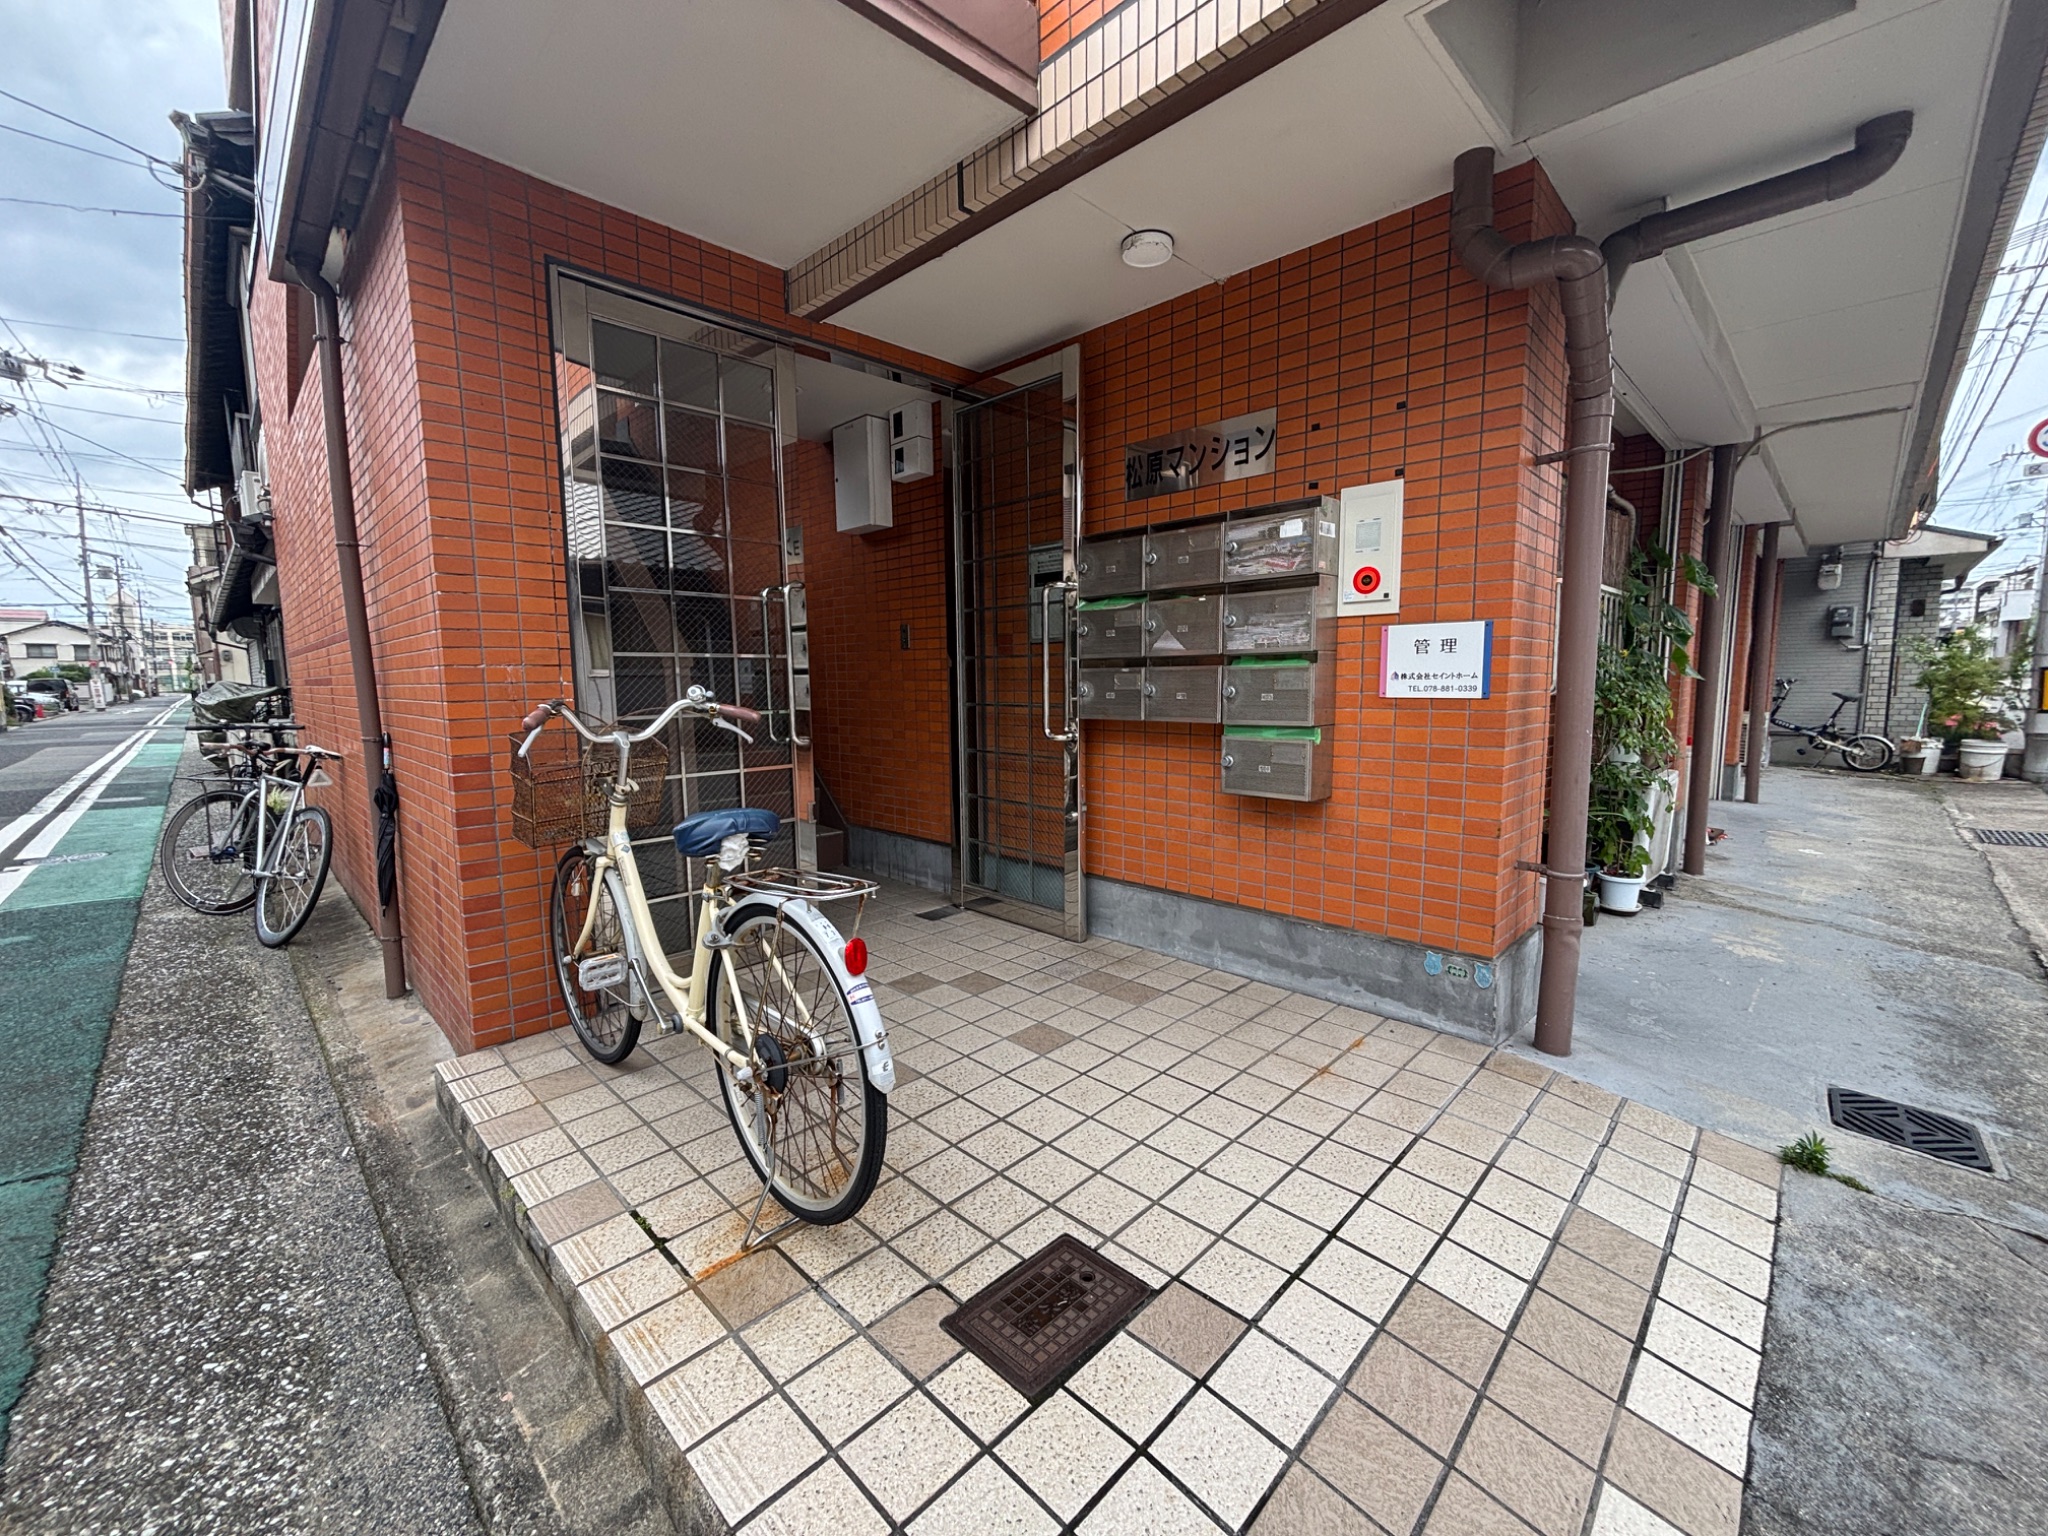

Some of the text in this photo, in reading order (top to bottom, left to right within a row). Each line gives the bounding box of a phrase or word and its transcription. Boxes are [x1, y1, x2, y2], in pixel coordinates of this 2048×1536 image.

[1126, 426, 1276, 490] 松原マンション
[1414, 638, 1457, 654] 管理
[1400, 671, 1478, 680] 株式会社セイントホーム
[1408, 685, 1478, 693] TEL.078-881-0339
